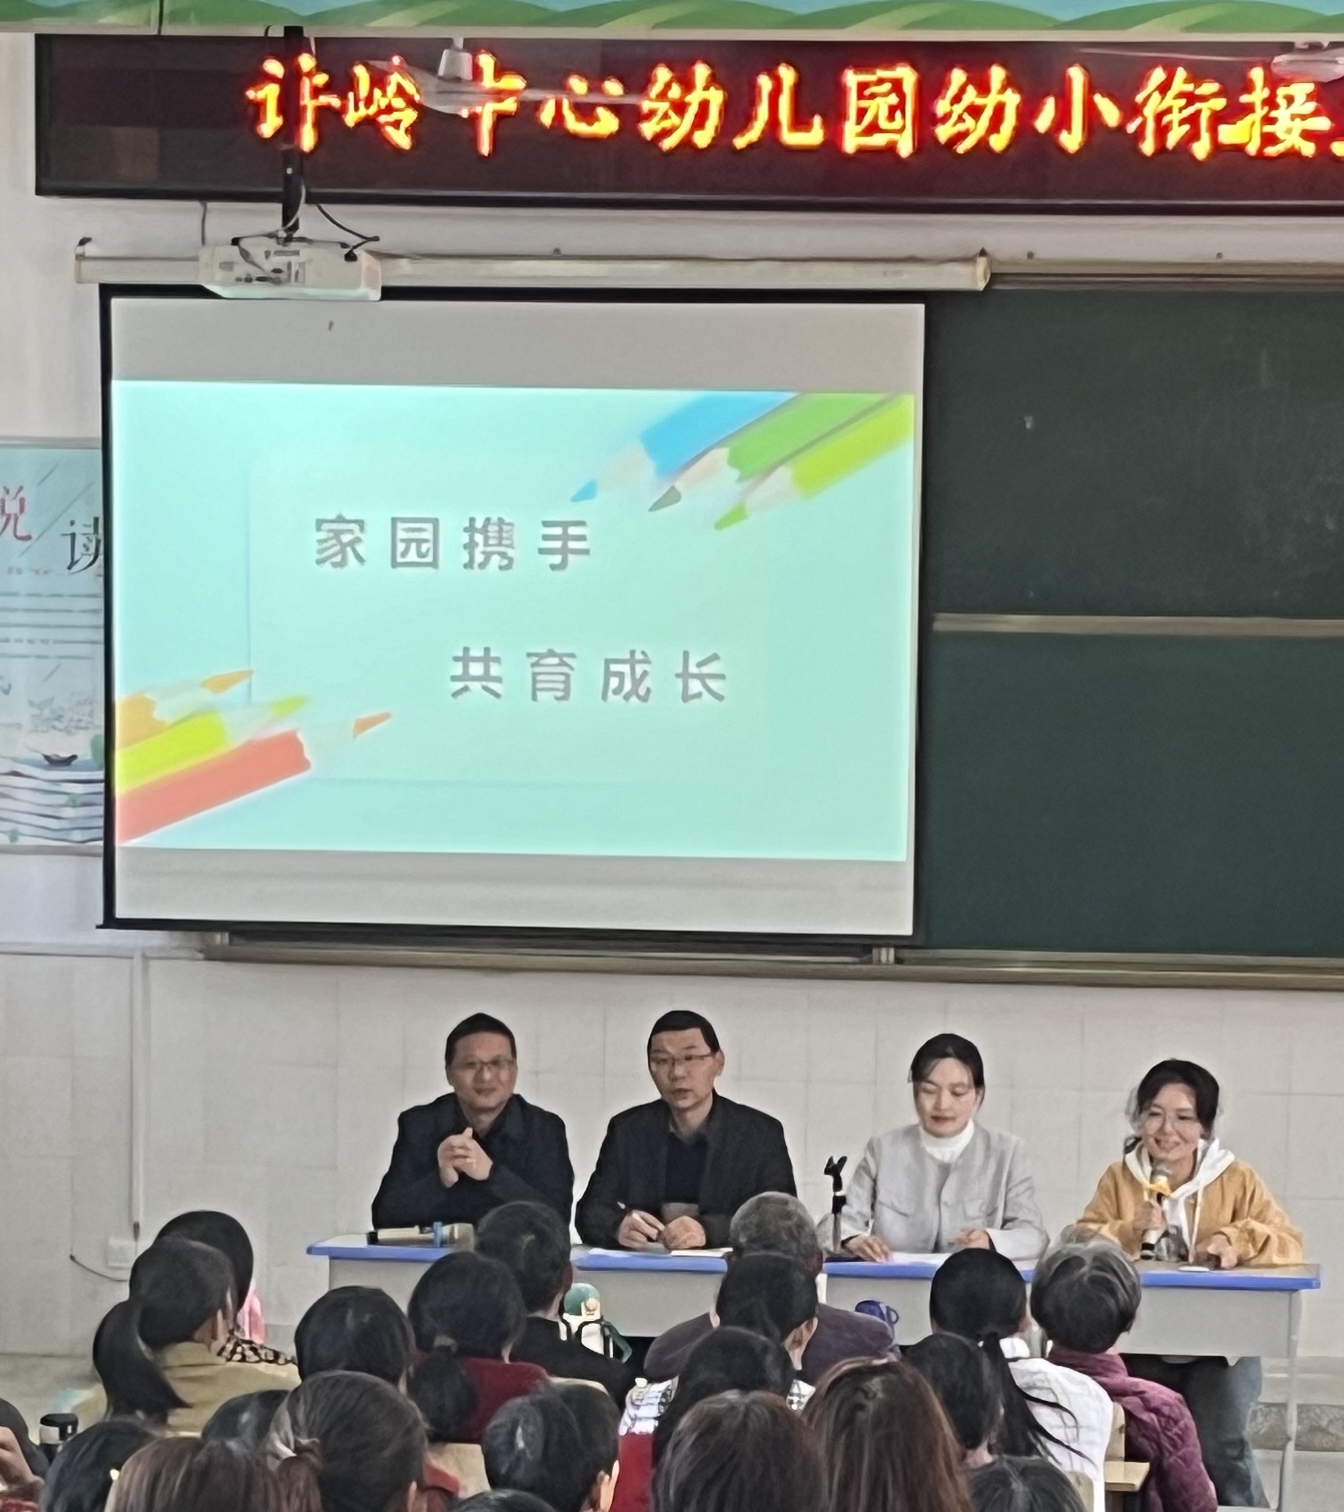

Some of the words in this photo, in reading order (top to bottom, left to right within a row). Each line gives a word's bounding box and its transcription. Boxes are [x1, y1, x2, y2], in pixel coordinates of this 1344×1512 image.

[312, 513, 593, 572] 家园携手
[449, 647, 729, 705] 共育成长
